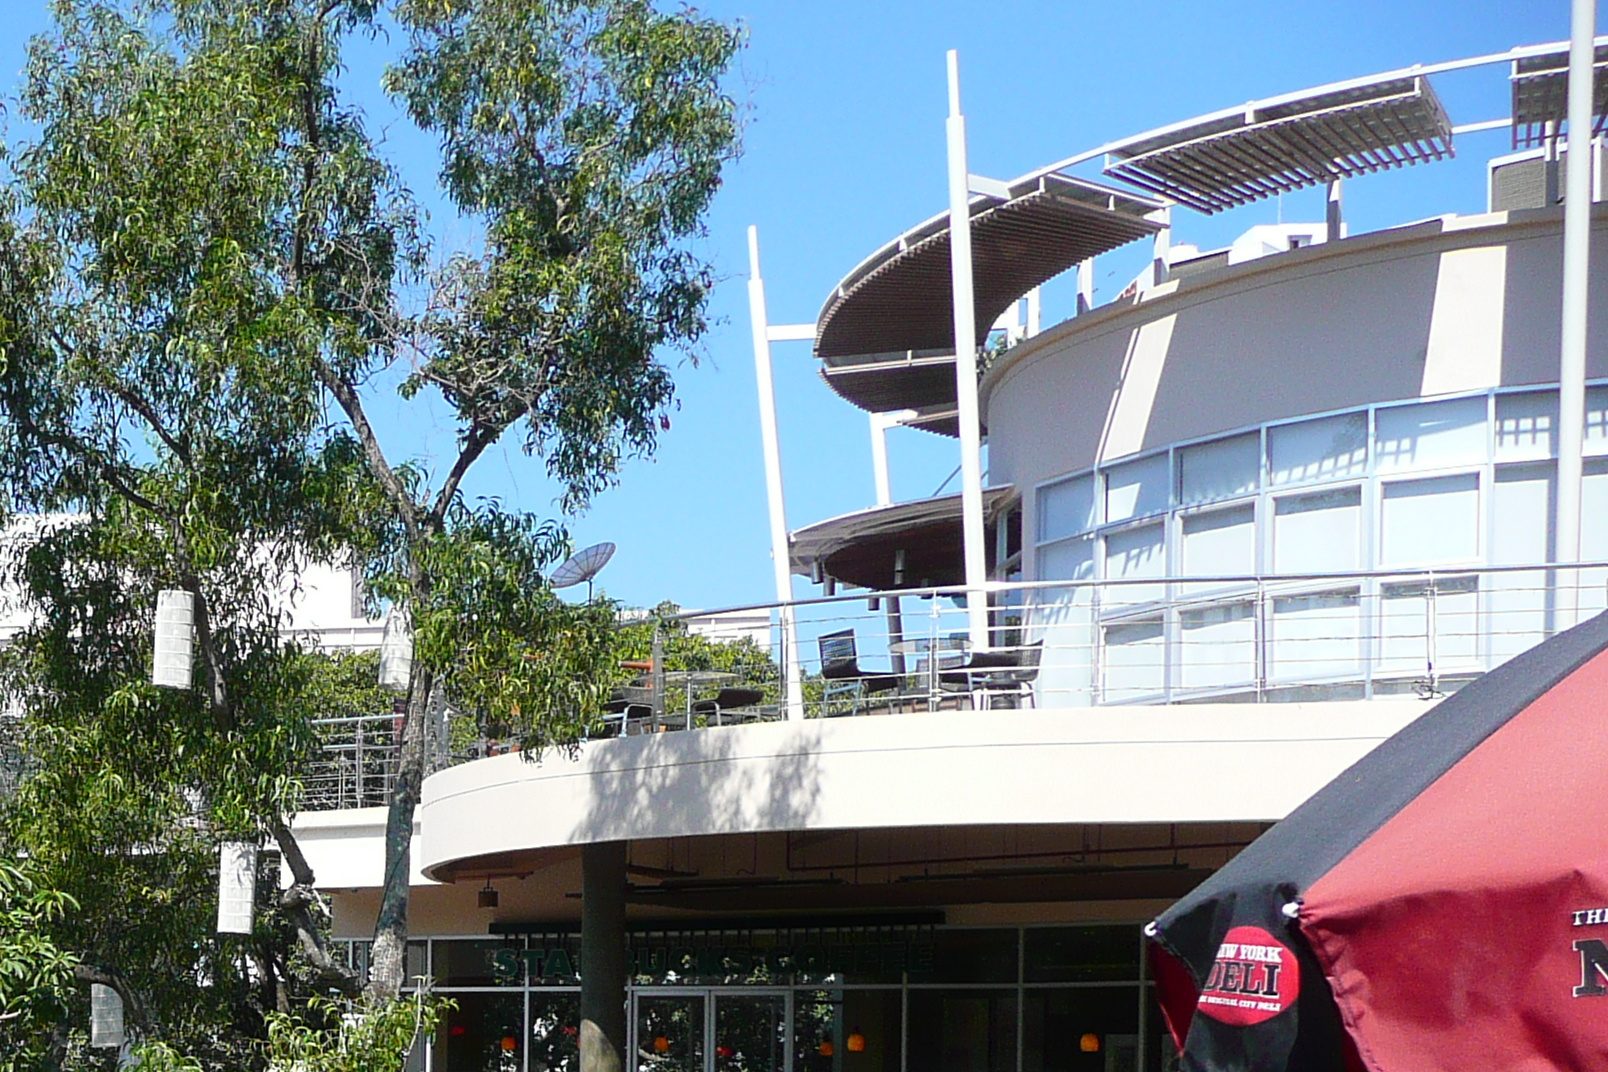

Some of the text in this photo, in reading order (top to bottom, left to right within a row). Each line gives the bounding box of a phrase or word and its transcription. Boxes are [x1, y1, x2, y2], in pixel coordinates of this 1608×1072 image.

[1572, 908, 1608, 926] TH
[1239, 944, 1283, 963] YORK
[1204, 960, 1282, 999] DELI
